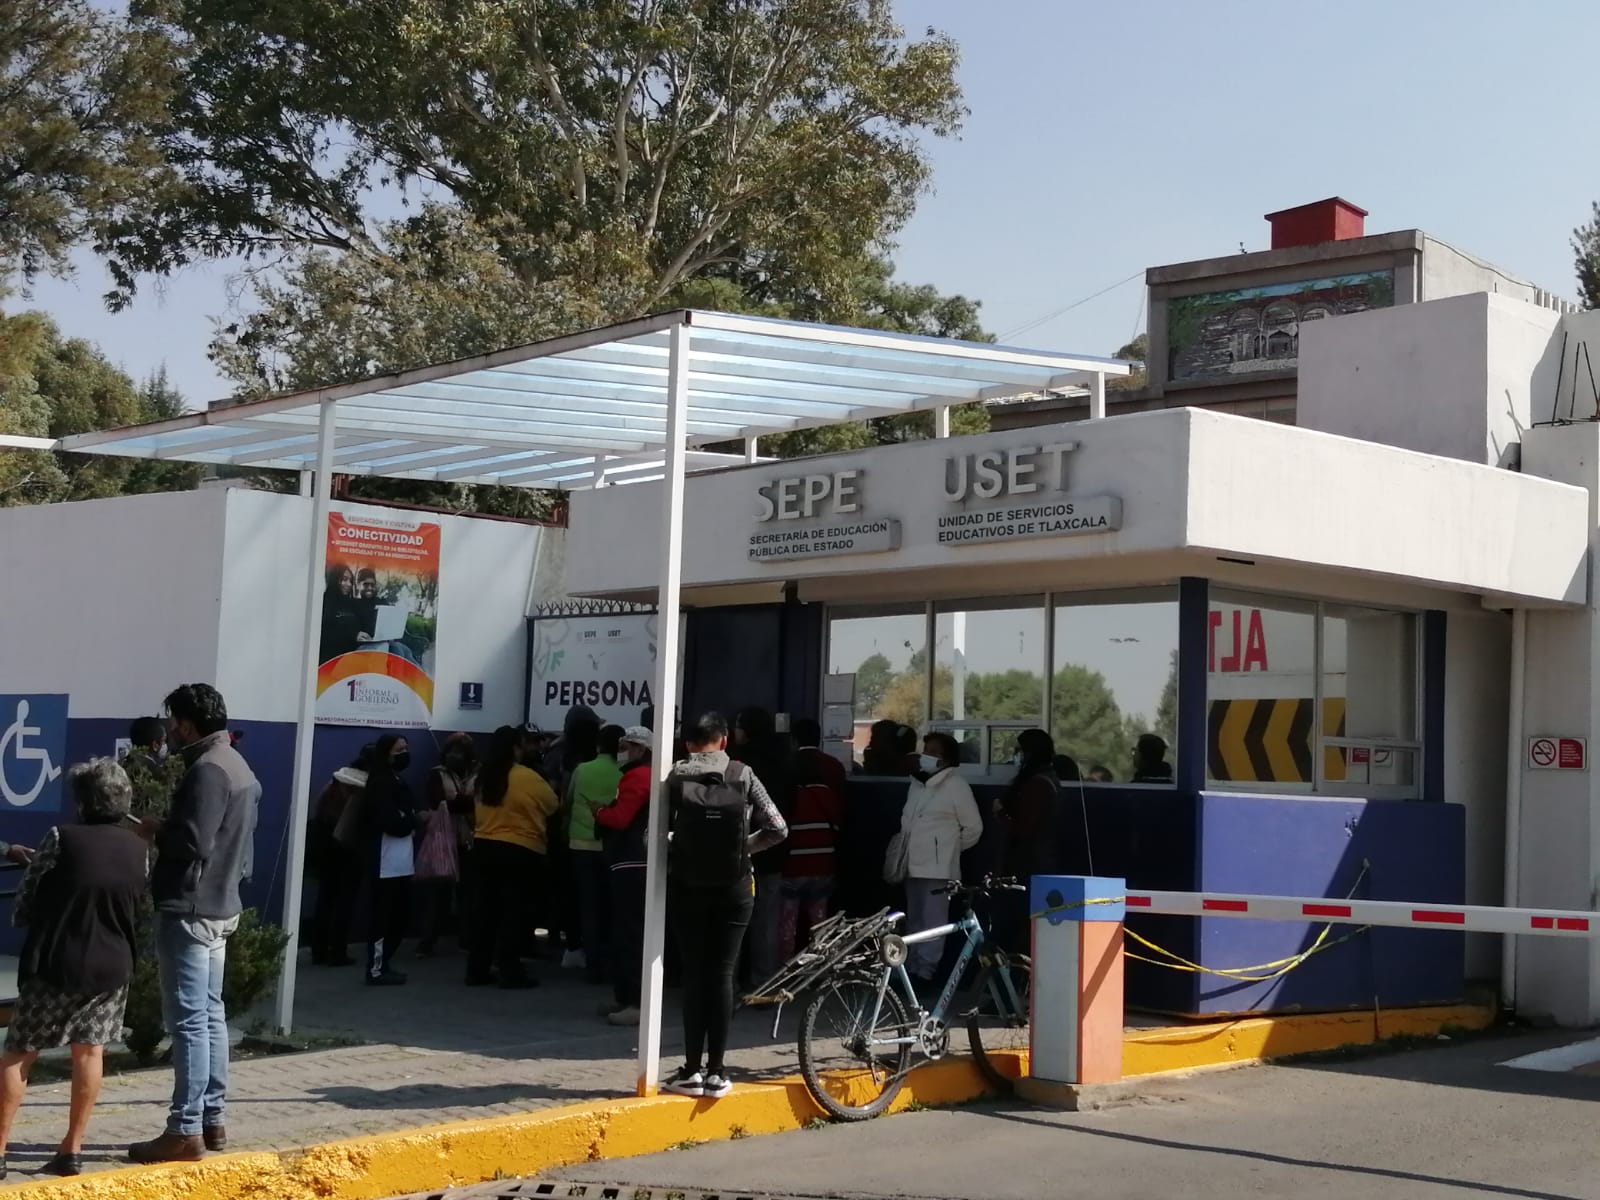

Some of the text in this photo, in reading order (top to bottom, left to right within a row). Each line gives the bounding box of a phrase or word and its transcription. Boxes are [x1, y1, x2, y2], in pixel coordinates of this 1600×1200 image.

[944, 441, 1073, 502] USET
[752, 469, 858, 522] SEPE
[938, 504, 1074, 528] UNIDAD DE SERVICIOS
[338, 527, 424, 546] CONECTIVIDAD
[750, 521, 887, 545] SECRETARÍA DE EDUCACIÓN
[938, 516, 1107, 542] EDUCATIVOS DE TLAXCALA
[749, 539, 854, 557] PÚBLICA DEL ESTADO
